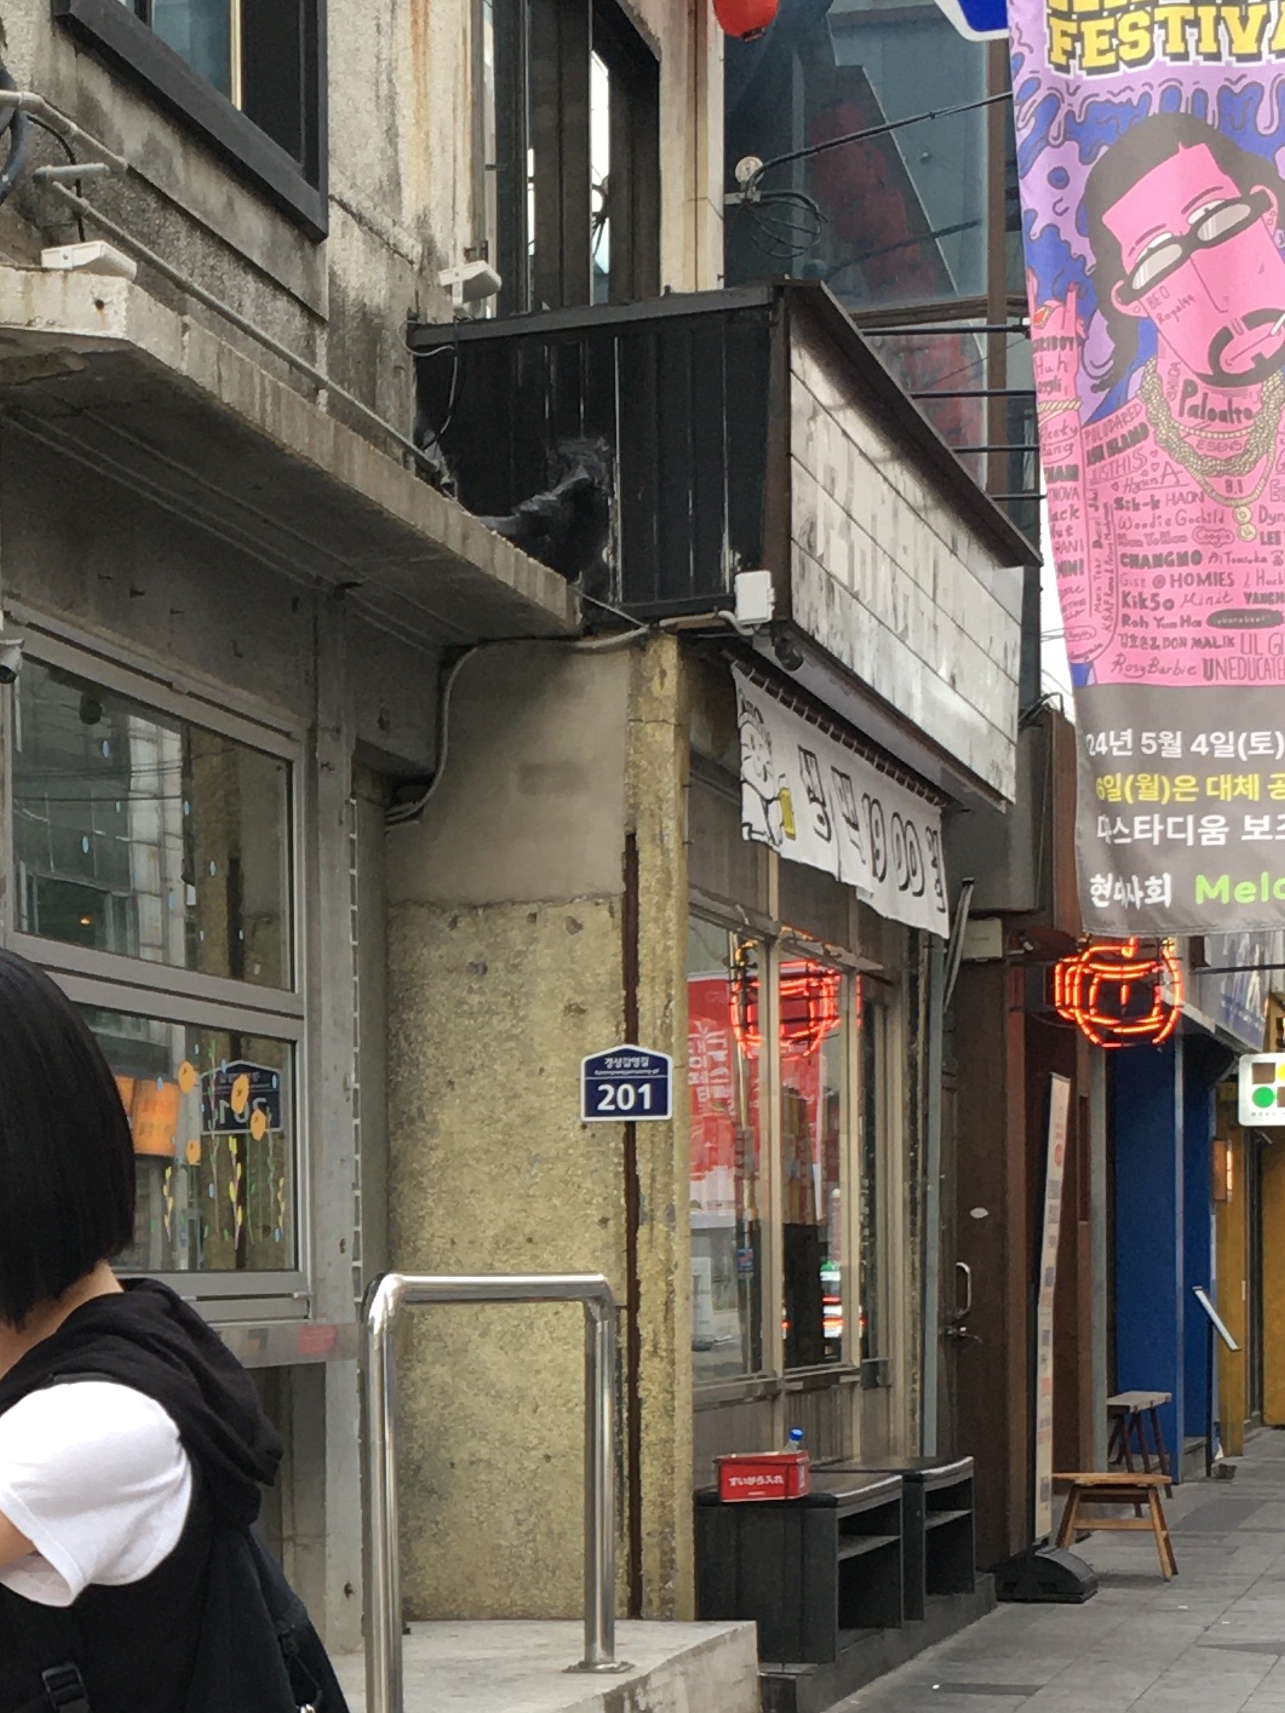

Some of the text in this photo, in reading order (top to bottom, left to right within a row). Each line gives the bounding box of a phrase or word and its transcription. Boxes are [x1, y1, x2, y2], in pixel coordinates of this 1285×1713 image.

[1179, 378, 1253, 424] Paloalto
[1141, 731, 1182, 758] 5월
[1191, 730, 1285, 761] 4일(토)
[1206, 773, 1260, 801] 대체
[597, 1083, 652, 1111] 201
